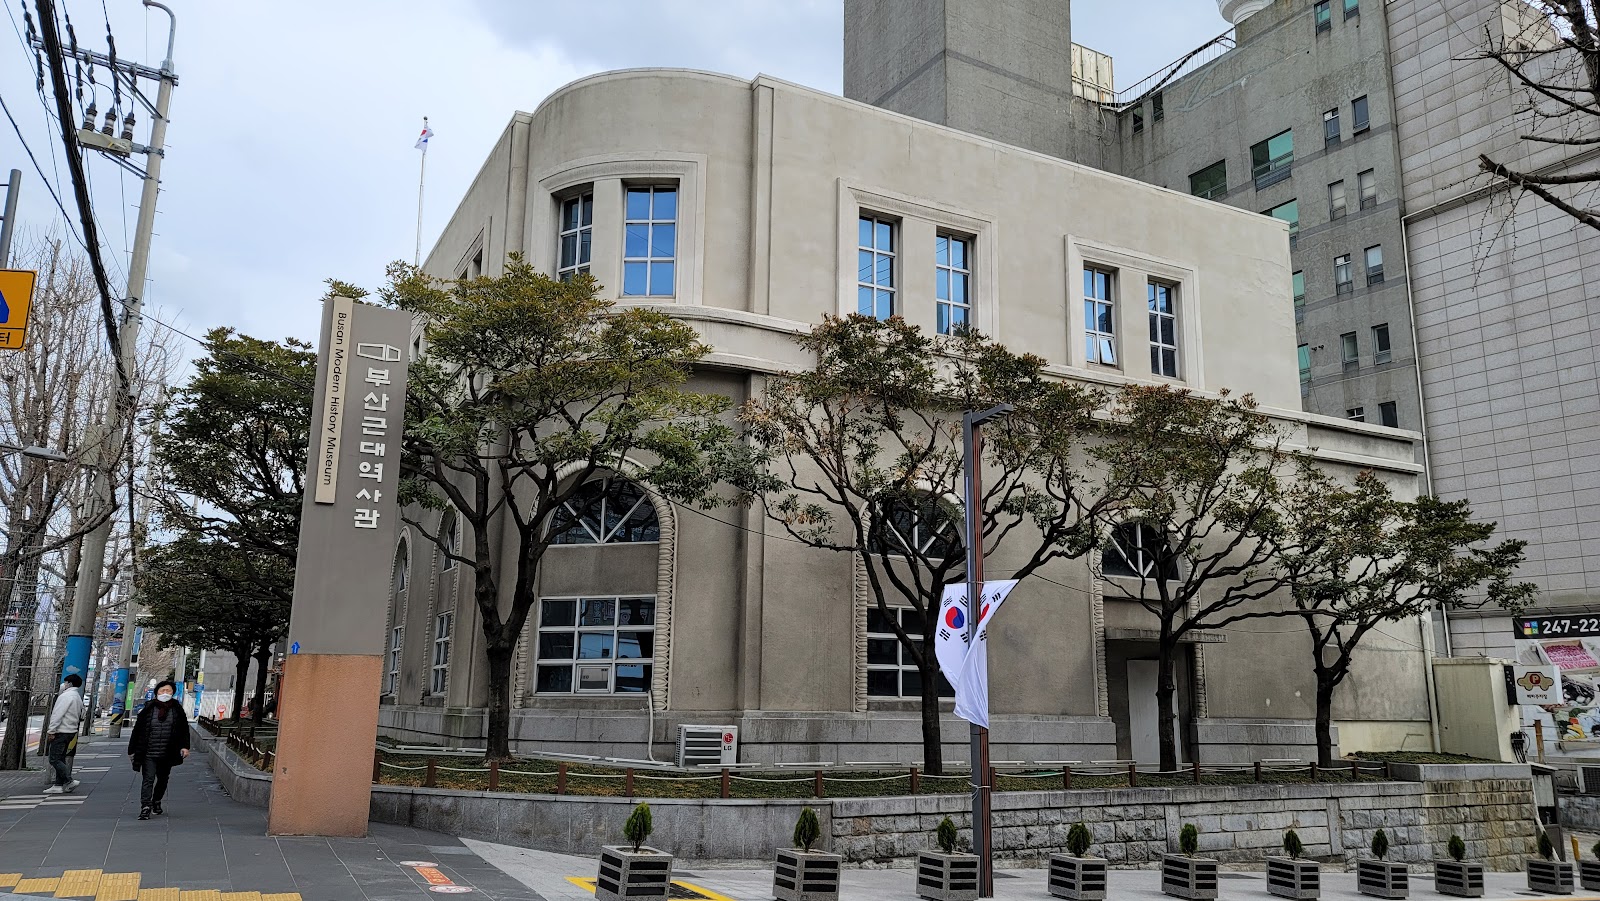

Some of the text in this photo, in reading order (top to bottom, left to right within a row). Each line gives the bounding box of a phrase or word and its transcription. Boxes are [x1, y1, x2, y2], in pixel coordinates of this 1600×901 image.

[323, 312, 347, 486] Busan Modern History Museum
[353, 367, 391, 529] 부산근대역사관
[1542, 618, 1600, 634] 247-22
